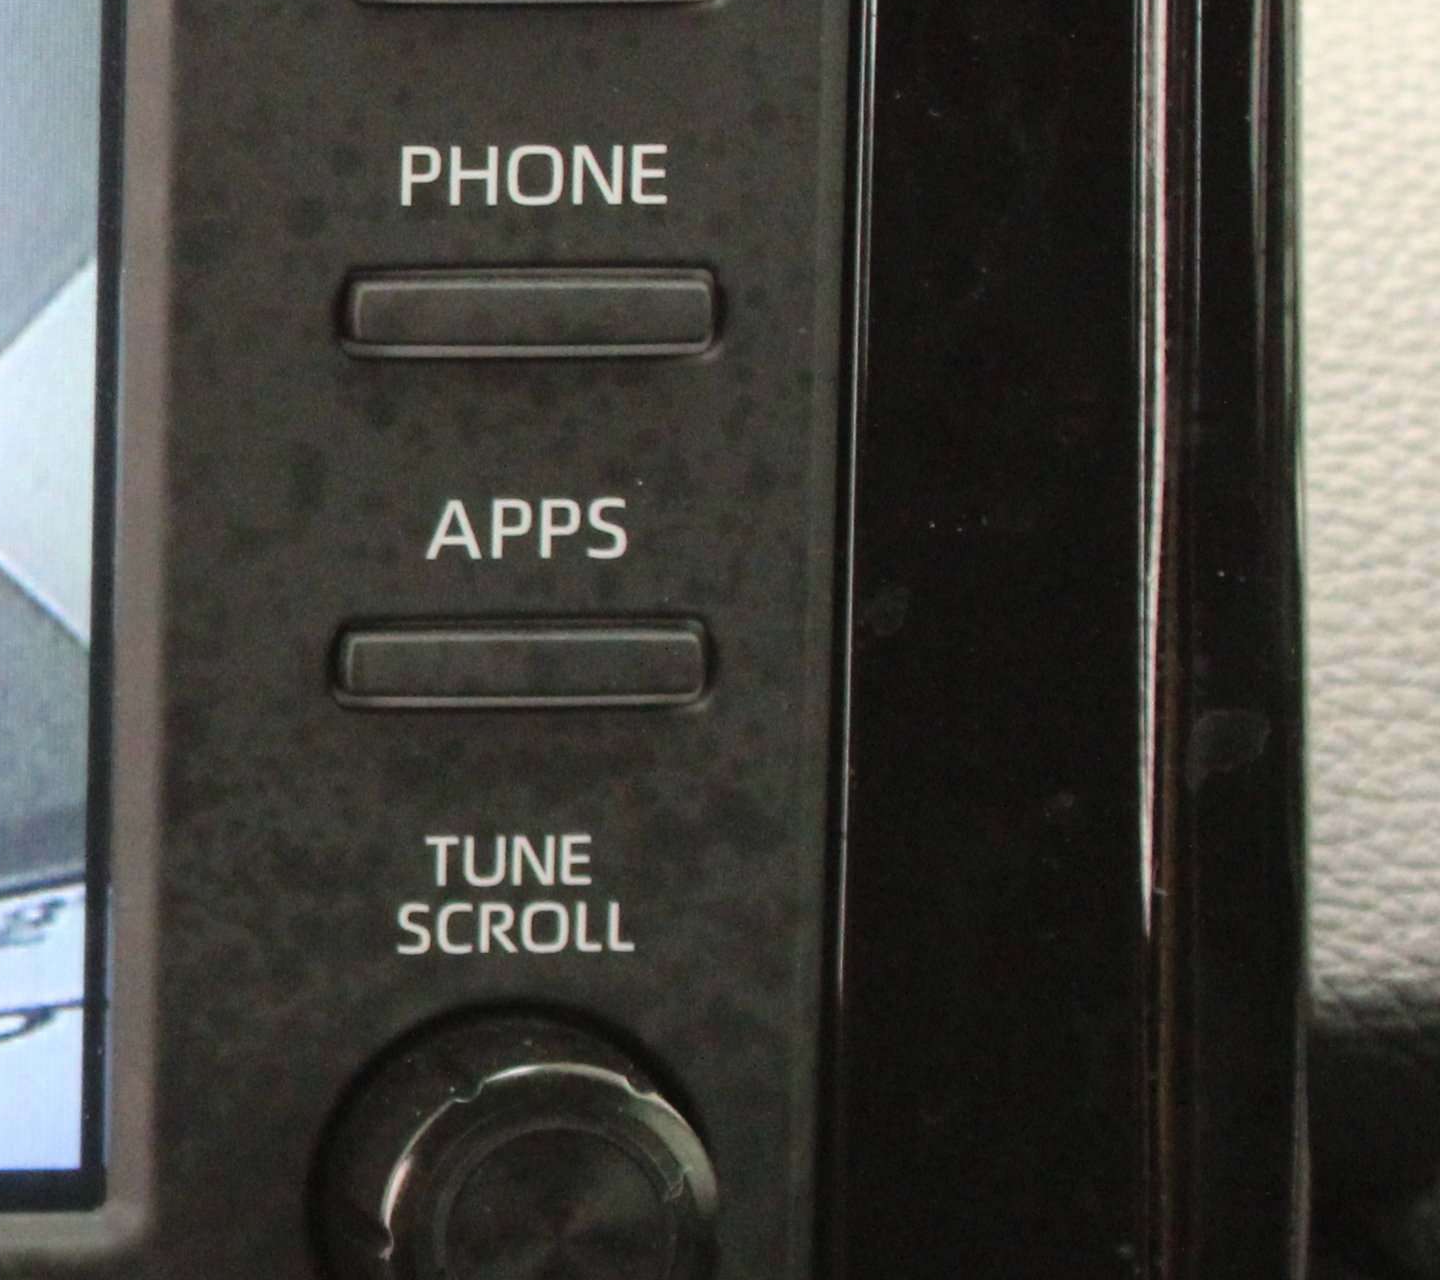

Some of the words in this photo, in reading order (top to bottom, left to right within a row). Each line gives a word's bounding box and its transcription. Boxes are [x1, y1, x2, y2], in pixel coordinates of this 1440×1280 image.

[401, 144, 668, 206] PHONE
[426, 497, 628, 560] APPS
[425, 834, 592, 887] TUNE
[397, 901, 635, 955] SCROLL
